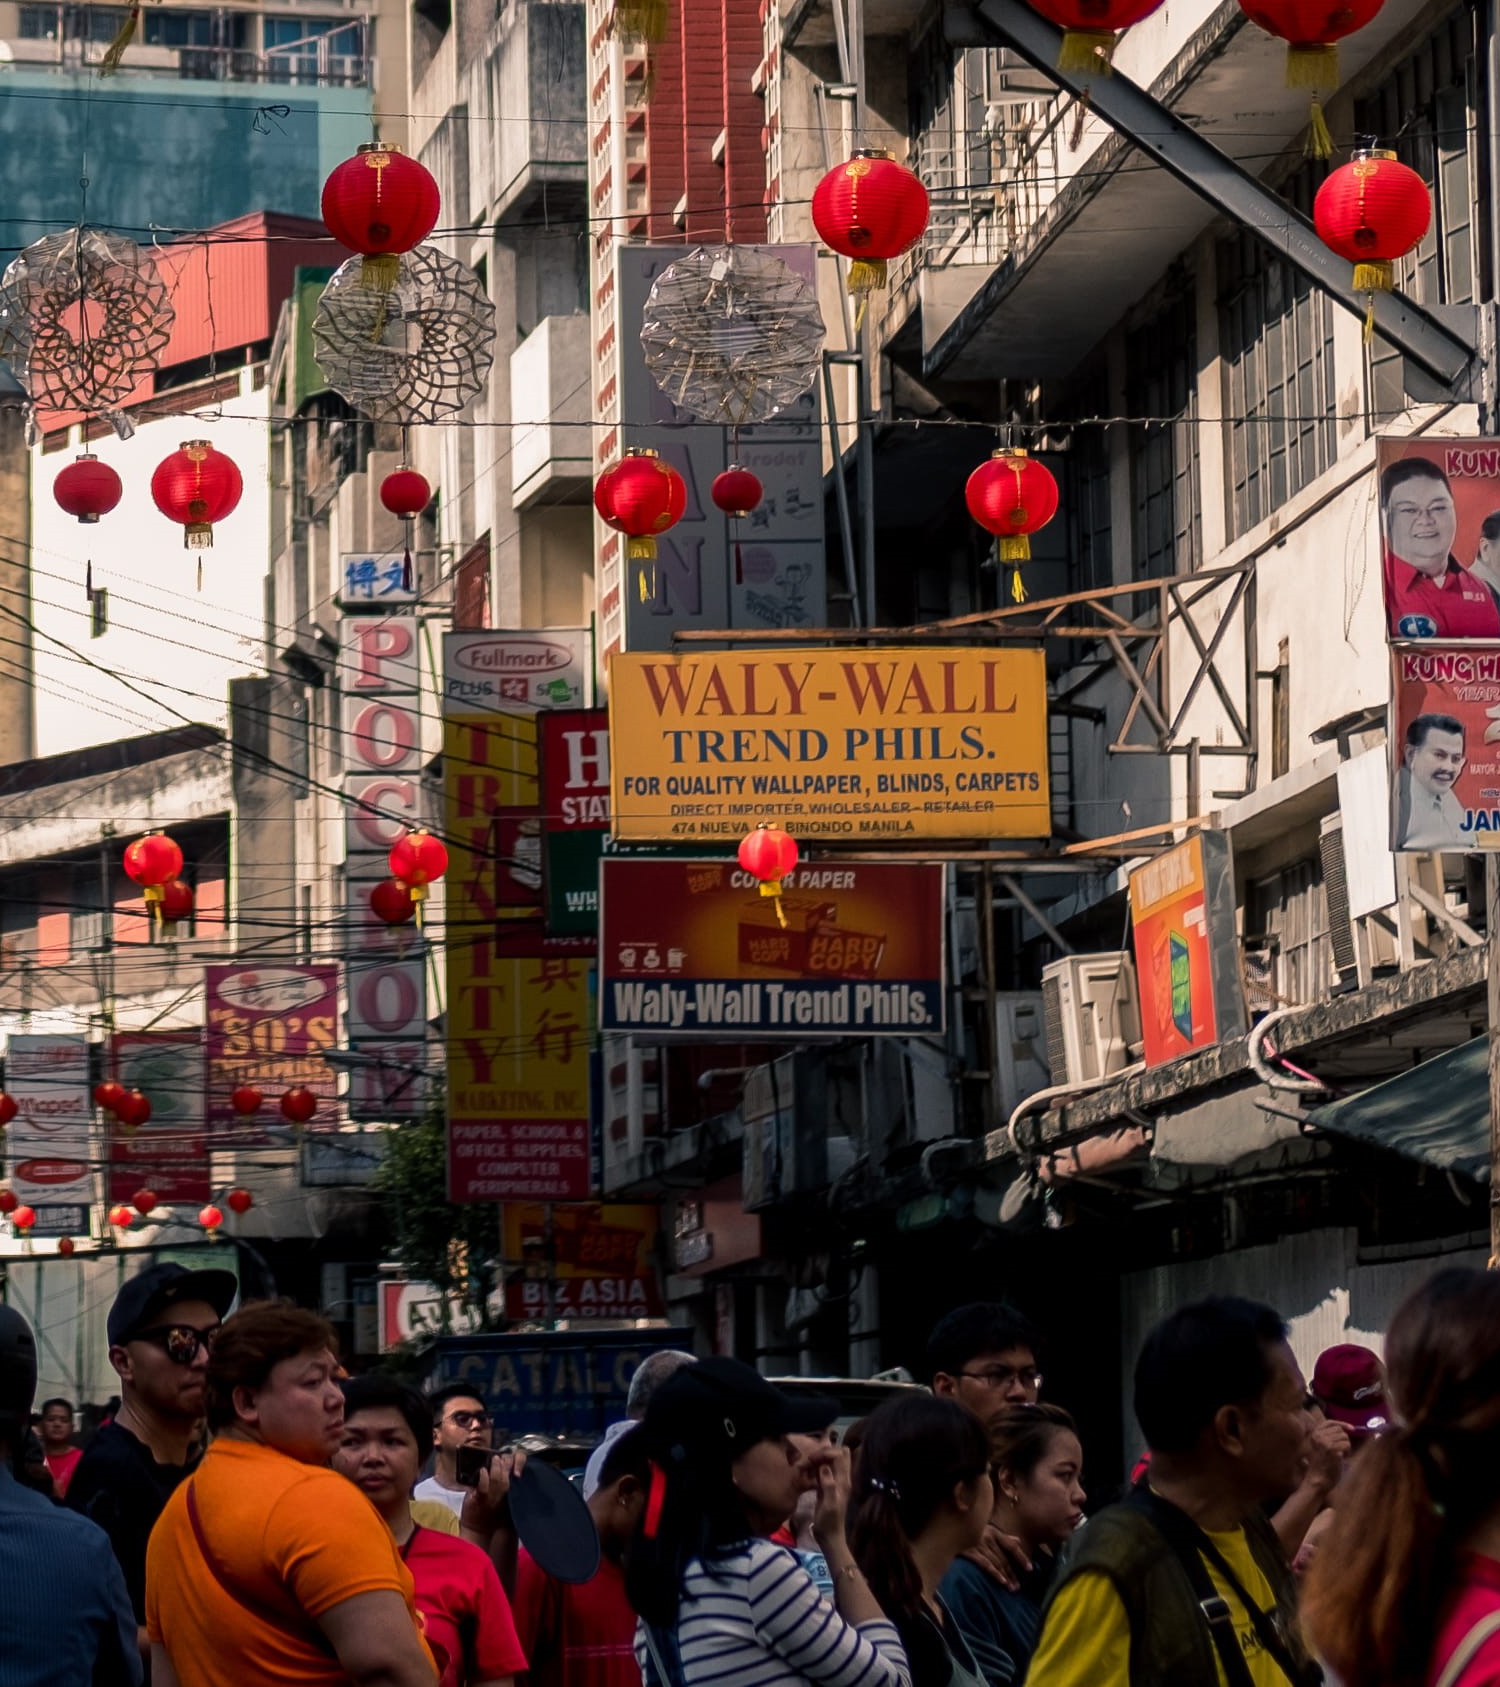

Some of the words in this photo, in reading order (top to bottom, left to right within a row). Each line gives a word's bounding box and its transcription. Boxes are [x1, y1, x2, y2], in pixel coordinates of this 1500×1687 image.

[470, 649, 558, 668] Fullmark
[1402, 653, 1475, 683] KUNG
[639, 659, 1018, 717] WALY-WALL
[1453, 686, 1500, 702] YEAR
[663, 728, 828, 763] TREND
[844, 725, 996, 761] PHILS.
[623, 776, 661, 796] FOR
[666, 775, 746, 796] QUALITY
[877, 773, 949, 796] BLINDS,
[955, 772, 1040, 793] CARPETS
[670, 802, 724, 817] DIRECT
[671, 822, 697, 835] 474
[700, 822, 749, 834] NUEVA
[785, 821, 854, 834] BINONDO
[858, 820, 916, 833] MANILA
[800, 870, 857, 889] PAPER
[811, 936, 878, 954] HARD
[809, 952, 877, 971] COPY
[613, 981, 763, 1027] Waly-Wall
[767, 983, 852, 1024] Trend
[856, 981, 933, 1025] Phils.
[510, 1125, 567, 1139] SCHOOL
[572, 1125, 585, 1139] &
[455, 1143, 507, 1158] OFFICE
[476, 1162, 561, 1176] COMPUTER
[467, 1180, 571, 1195] PERIPHERALS
[577, 1278, 648, 1304] ASIA
